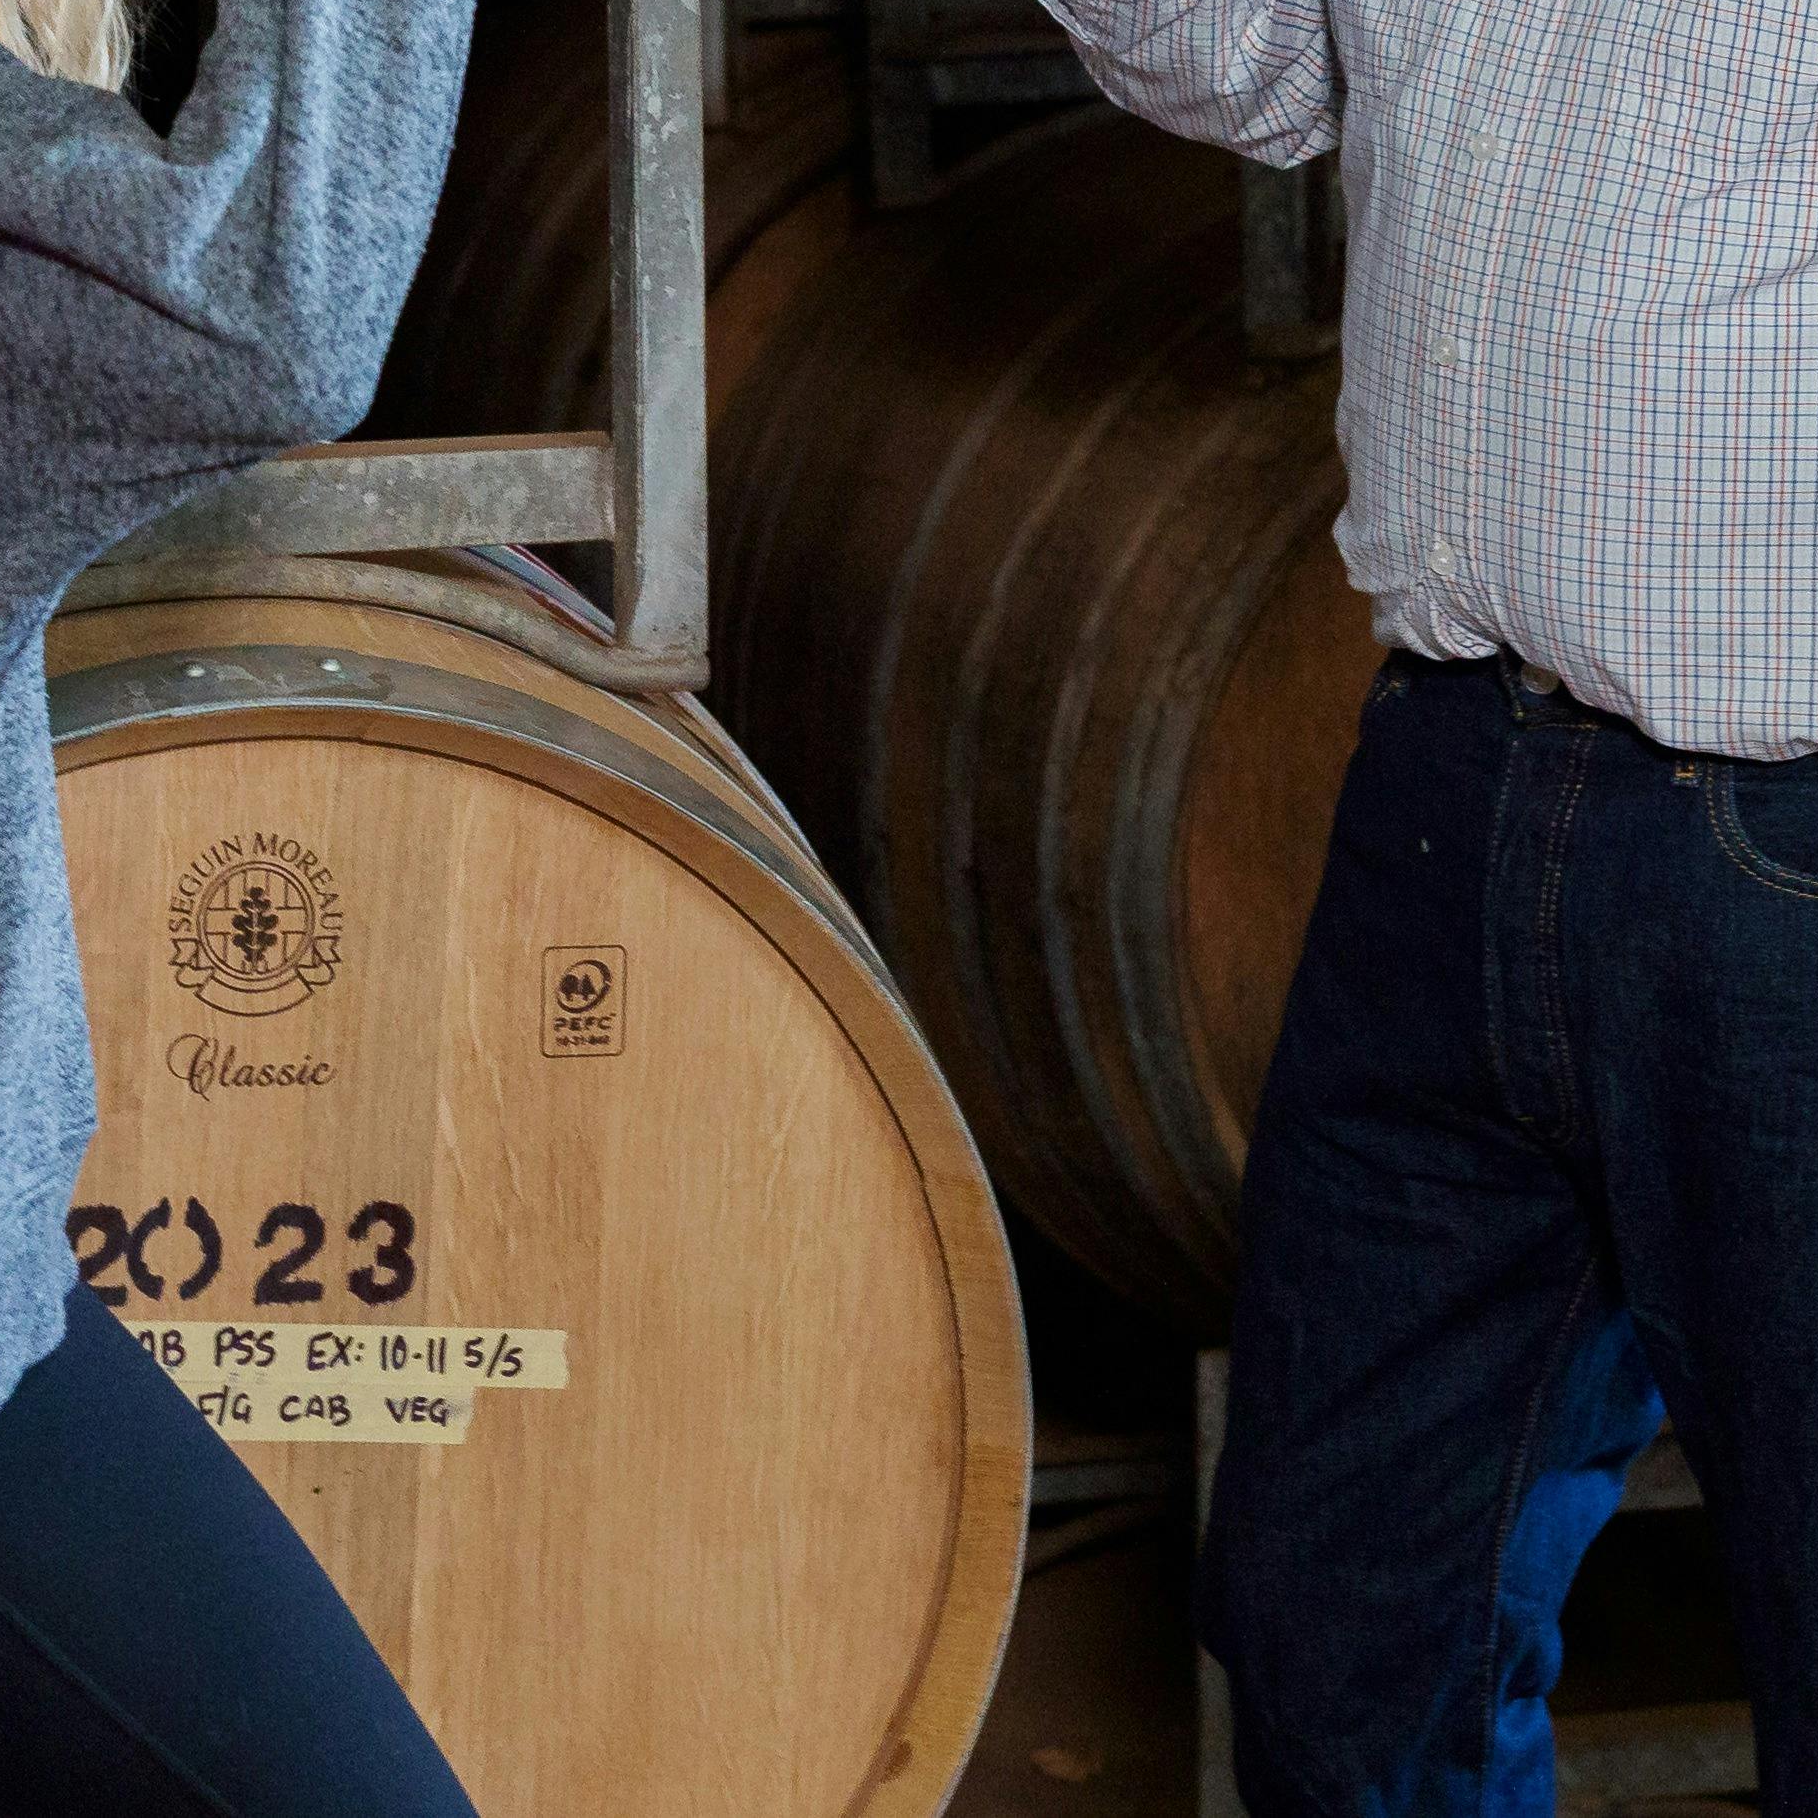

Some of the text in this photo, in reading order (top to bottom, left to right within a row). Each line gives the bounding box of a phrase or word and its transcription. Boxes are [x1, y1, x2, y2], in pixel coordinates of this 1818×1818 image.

[168, 831, 344, 933] SEGUIN MOREAU
[165, 1032, 338, 1101] Classic
[213, 1325, 277, 1368] PSS
[464, 1332, 524, 1378] 5/5
[279, 1393, 352, 1427] CAB
[384, 1396, 451, 1428] VEG
